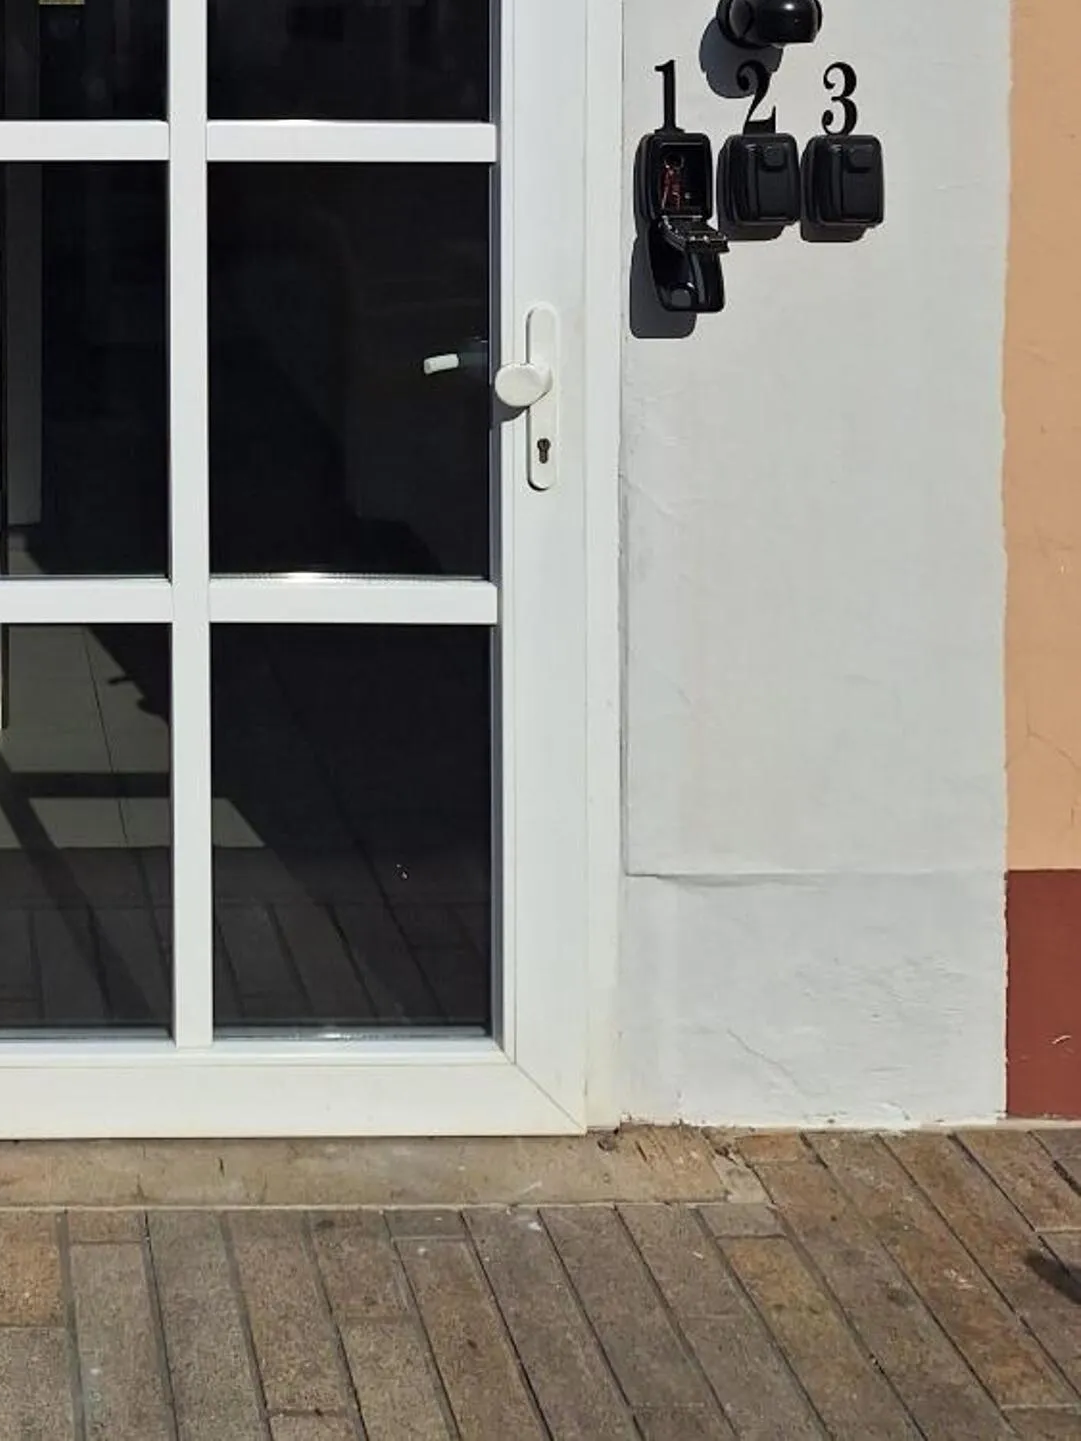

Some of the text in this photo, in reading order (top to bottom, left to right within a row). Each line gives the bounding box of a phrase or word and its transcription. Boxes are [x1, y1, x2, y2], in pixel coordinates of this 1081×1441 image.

[655, 60, 685, 133] 1
[736, 61, 776, 134] 2
[822, 62, 857, 135] 3
